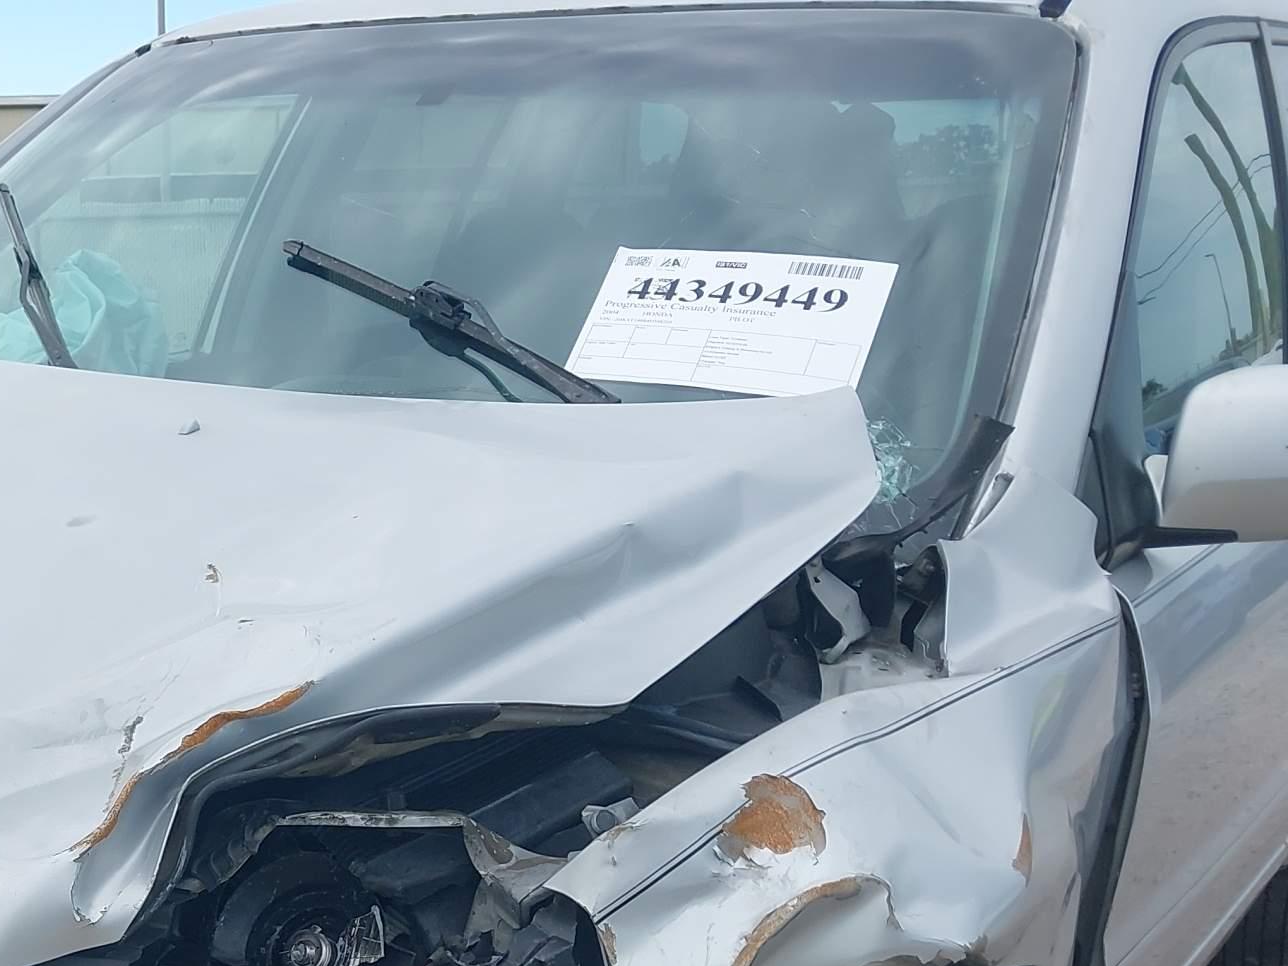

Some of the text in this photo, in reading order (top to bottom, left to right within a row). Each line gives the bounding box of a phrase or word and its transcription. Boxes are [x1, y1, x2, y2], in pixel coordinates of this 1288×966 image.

[604, 299, 777, 318] Progressive Casualty Insurance
[627, 277, 849, 313] 44349449
